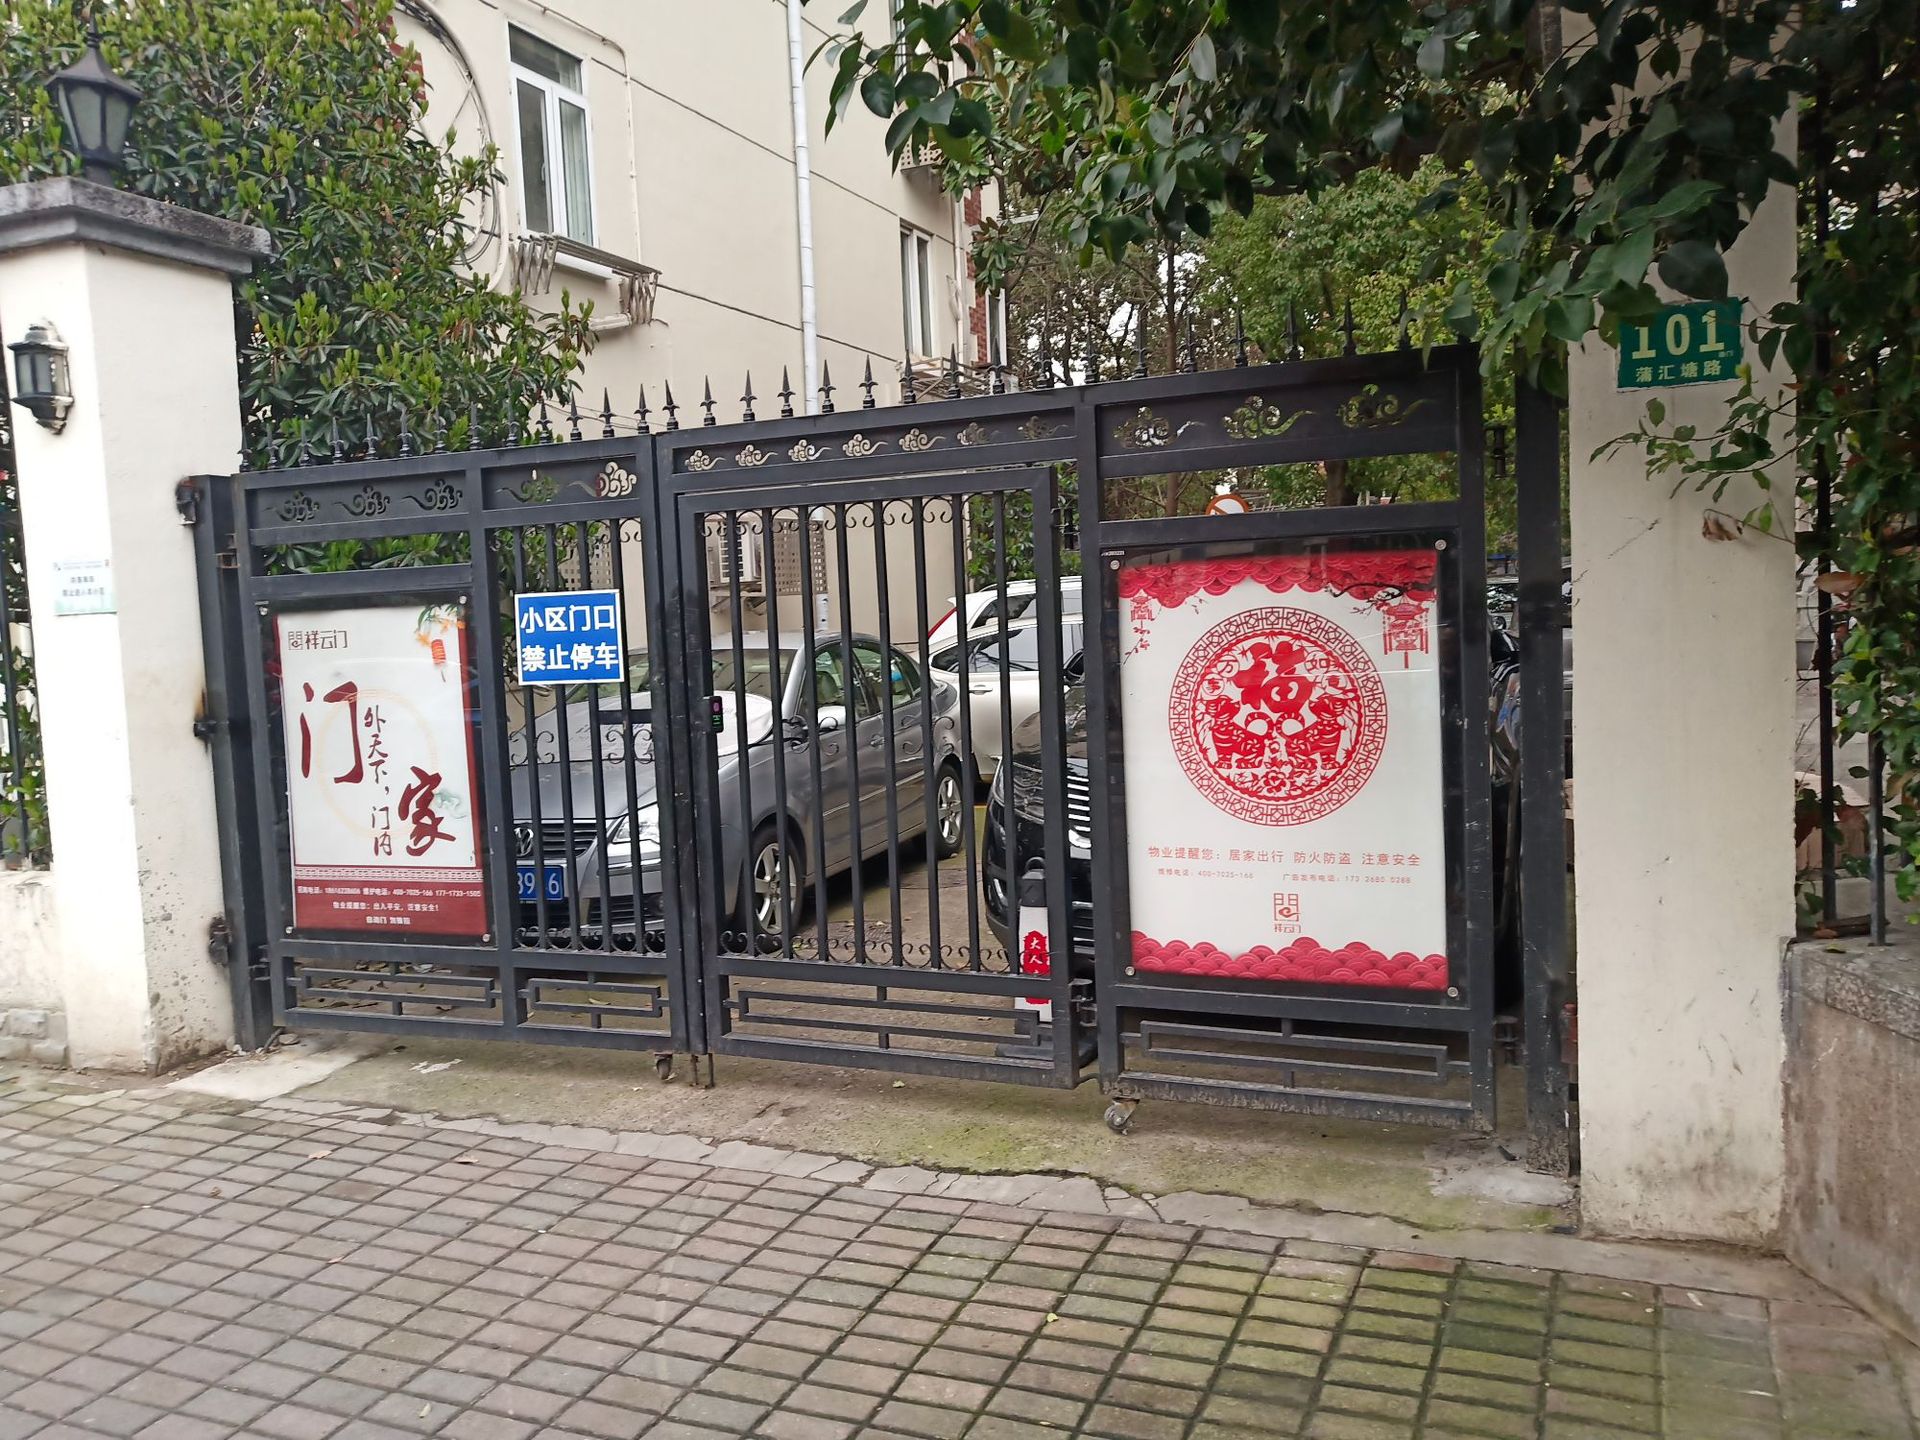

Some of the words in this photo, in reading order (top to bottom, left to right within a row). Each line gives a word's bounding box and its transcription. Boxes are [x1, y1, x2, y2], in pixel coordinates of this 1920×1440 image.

[1631, 309, 1725, 360] 101
[1635, 359, 1722, 383] 蒲汇塘路
[520, 604, 615, 634] 小区门口
[521, 641, 619, 672] 禁止停车
[299, 681, 364, 785] 门
[397, 765, 457, 858] 家
[1293, 850, 1353, 865] 防火防盗
[1361, 852, 1421, 867] 注意安全
